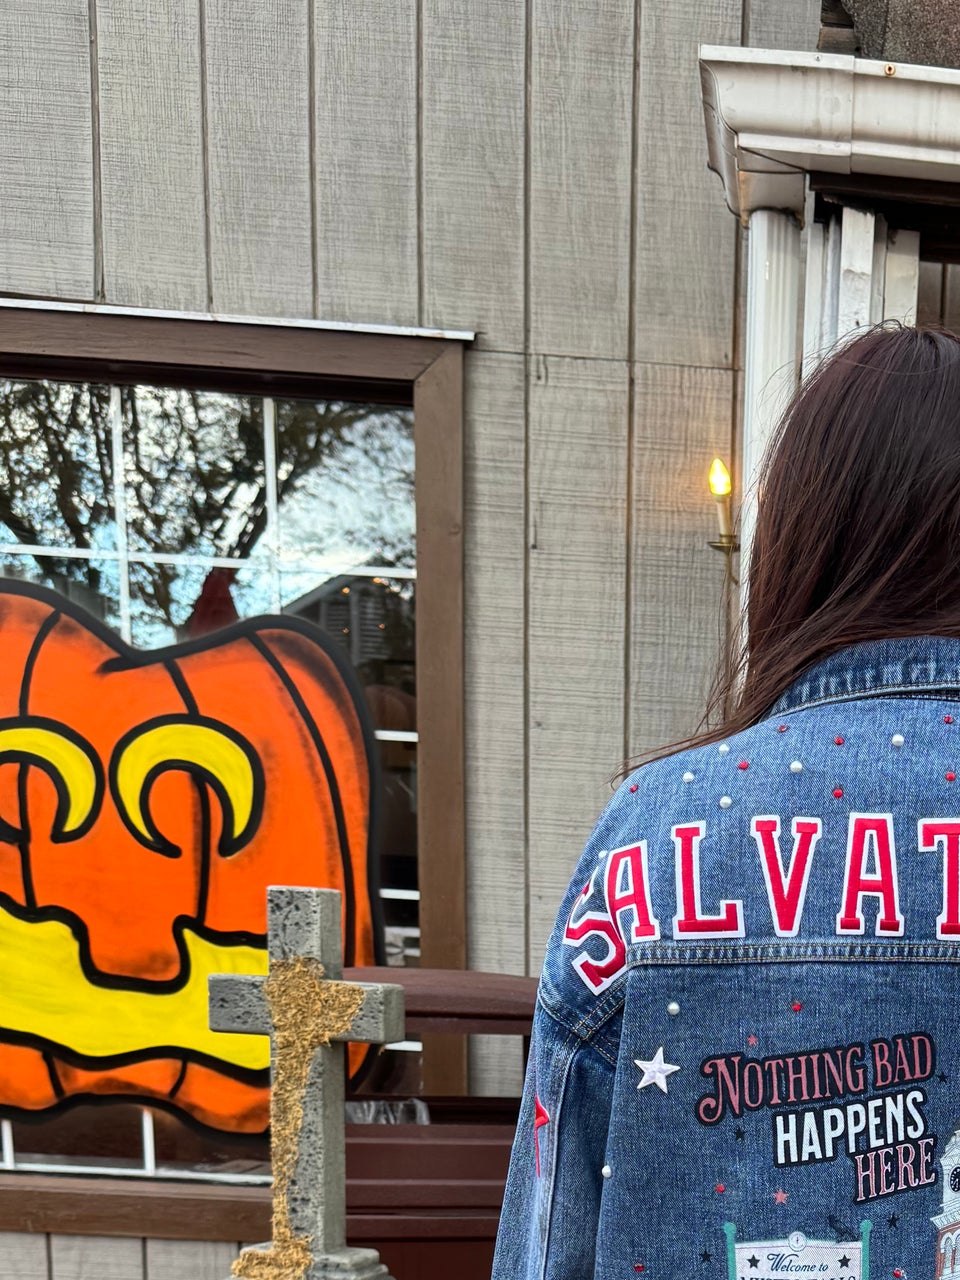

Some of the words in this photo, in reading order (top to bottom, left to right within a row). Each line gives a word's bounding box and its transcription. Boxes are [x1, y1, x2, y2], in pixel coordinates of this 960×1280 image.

[698, 1046, 864, 1123] NOTHING
[872, 1035, 932, 1087] BAD
[775, 1090, 925, 1164] HAPPENS
[854, 1138, 936, 1202] HERE
[766, 1253, 817, 1272] Welcome
[818, 1263, 829, 1272] to
